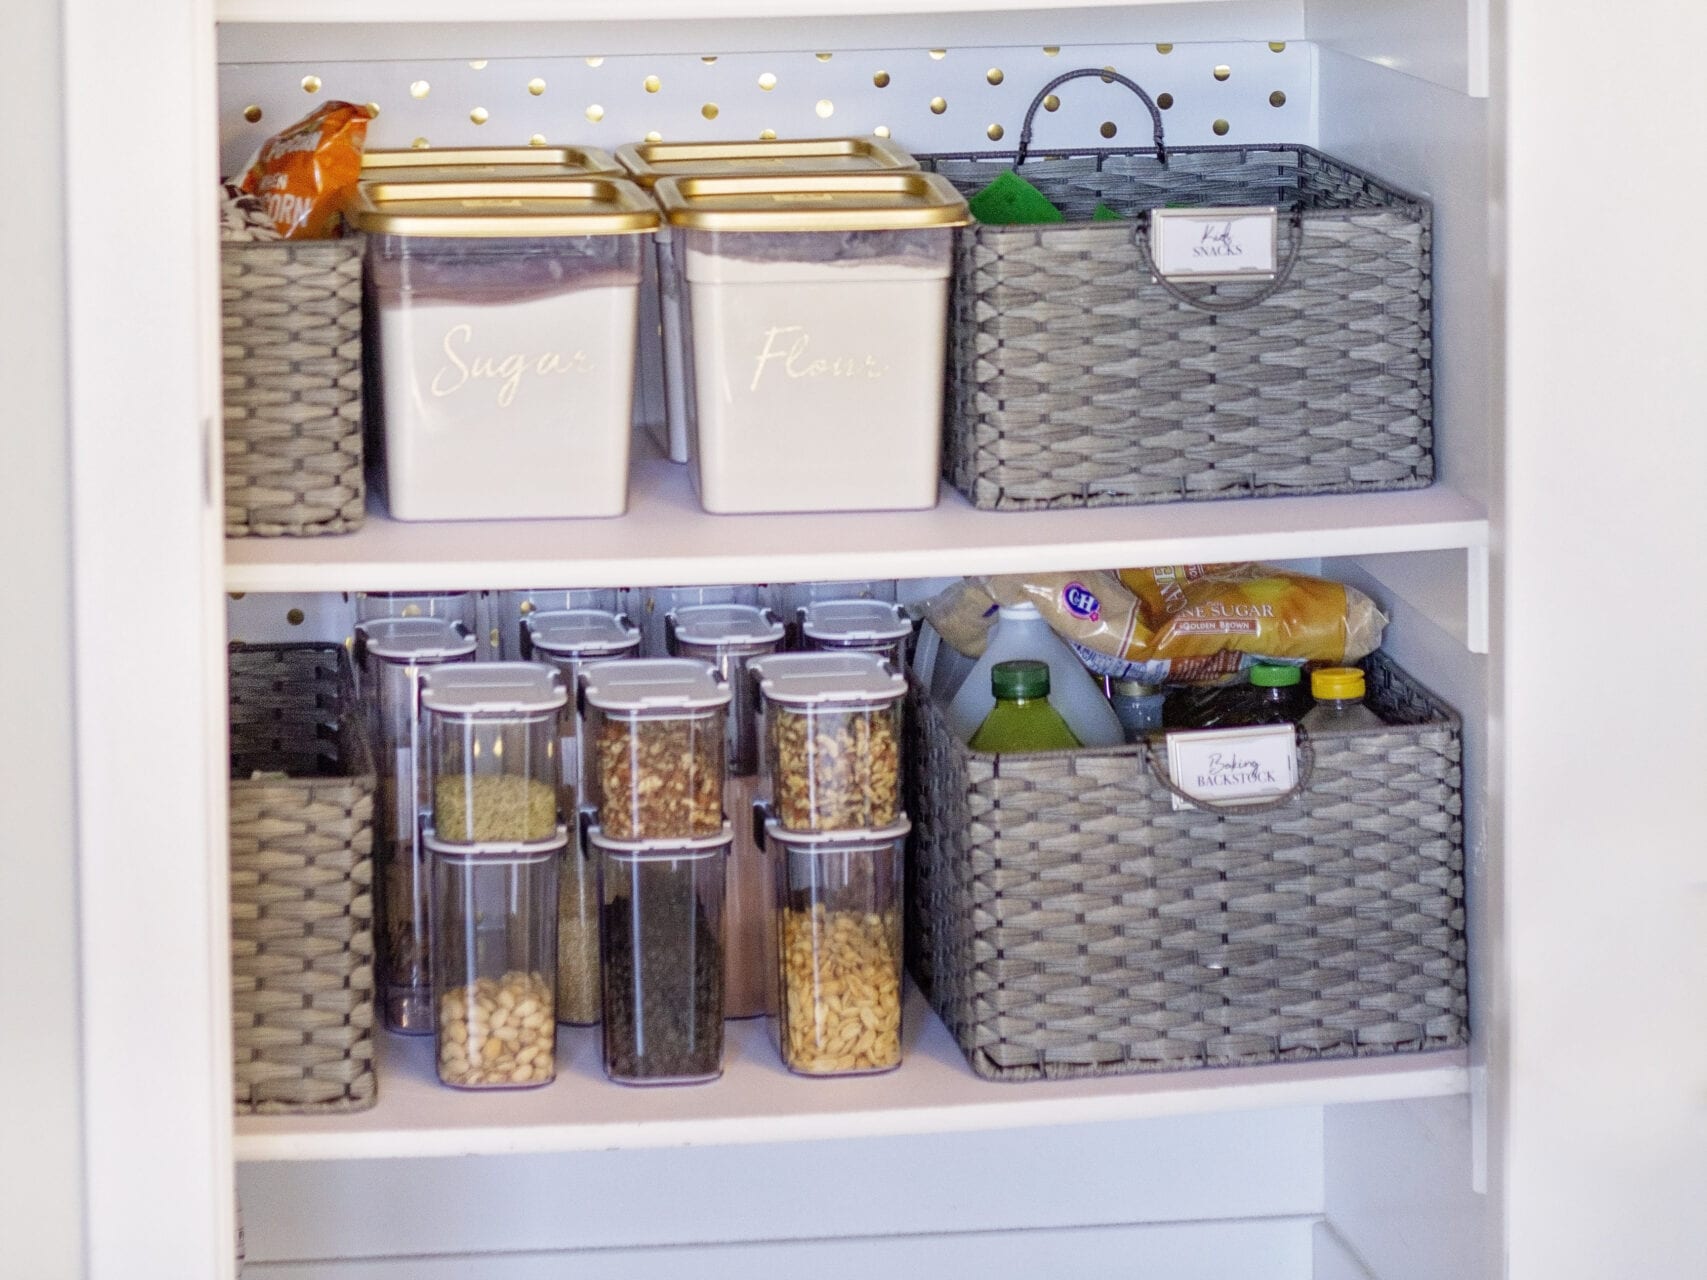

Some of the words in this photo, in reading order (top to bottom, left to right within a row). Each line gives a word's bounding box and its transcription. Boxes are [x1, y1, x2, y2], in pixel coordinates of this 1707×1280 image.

[264, 192, 313, 228] ORN
[1193, 245, 1242, 257] SNACKS
[431, 323, 594, 408] Sugar
[750, 325, 890, 392] Flour
[1210, 603, 1275, 618] SUGAR
[1183, 621, 1216, 631] GOLDEN
[1220, 620, 1250, 631] BROWN
[1208, 752, 1260, 776] Baking
[1197, 770, 1276, 788] BACKSTOCK
